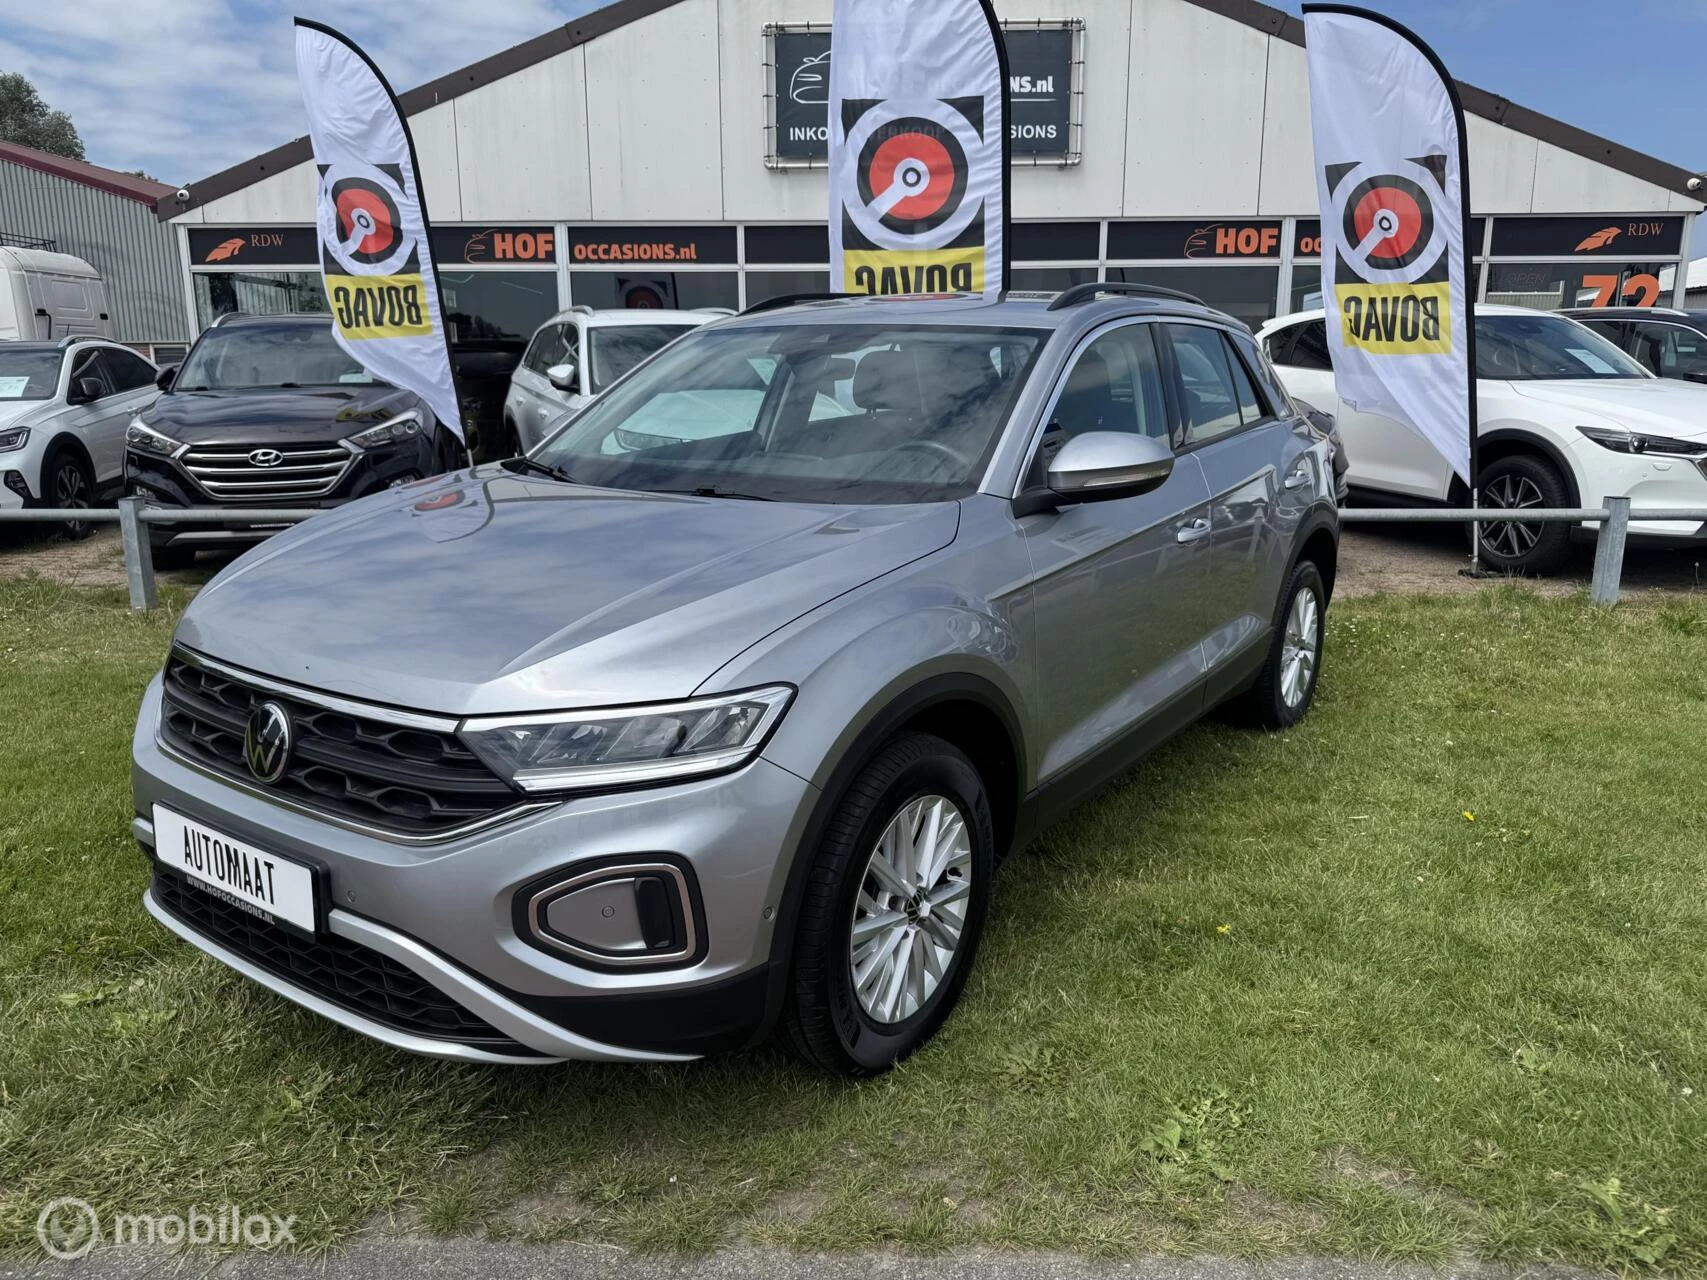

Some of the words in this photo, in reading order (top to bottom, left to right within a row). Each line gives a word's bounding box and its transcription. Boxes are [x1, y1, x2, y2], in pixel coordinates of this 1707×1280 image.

[789, 126, 829, 141] INKO
[250, 233, 285, 247] RDW
[1214, 227, 1279, 255] HOF
[1627, 222, 1665, 237] RDW
[493, 232, 554, 259] HOF
[573, 242, 697, 260] OCCASIONS.nl
[1581, 273, 1661, 308] 72
[183, 825, 275, 906] AUTOMAAT
